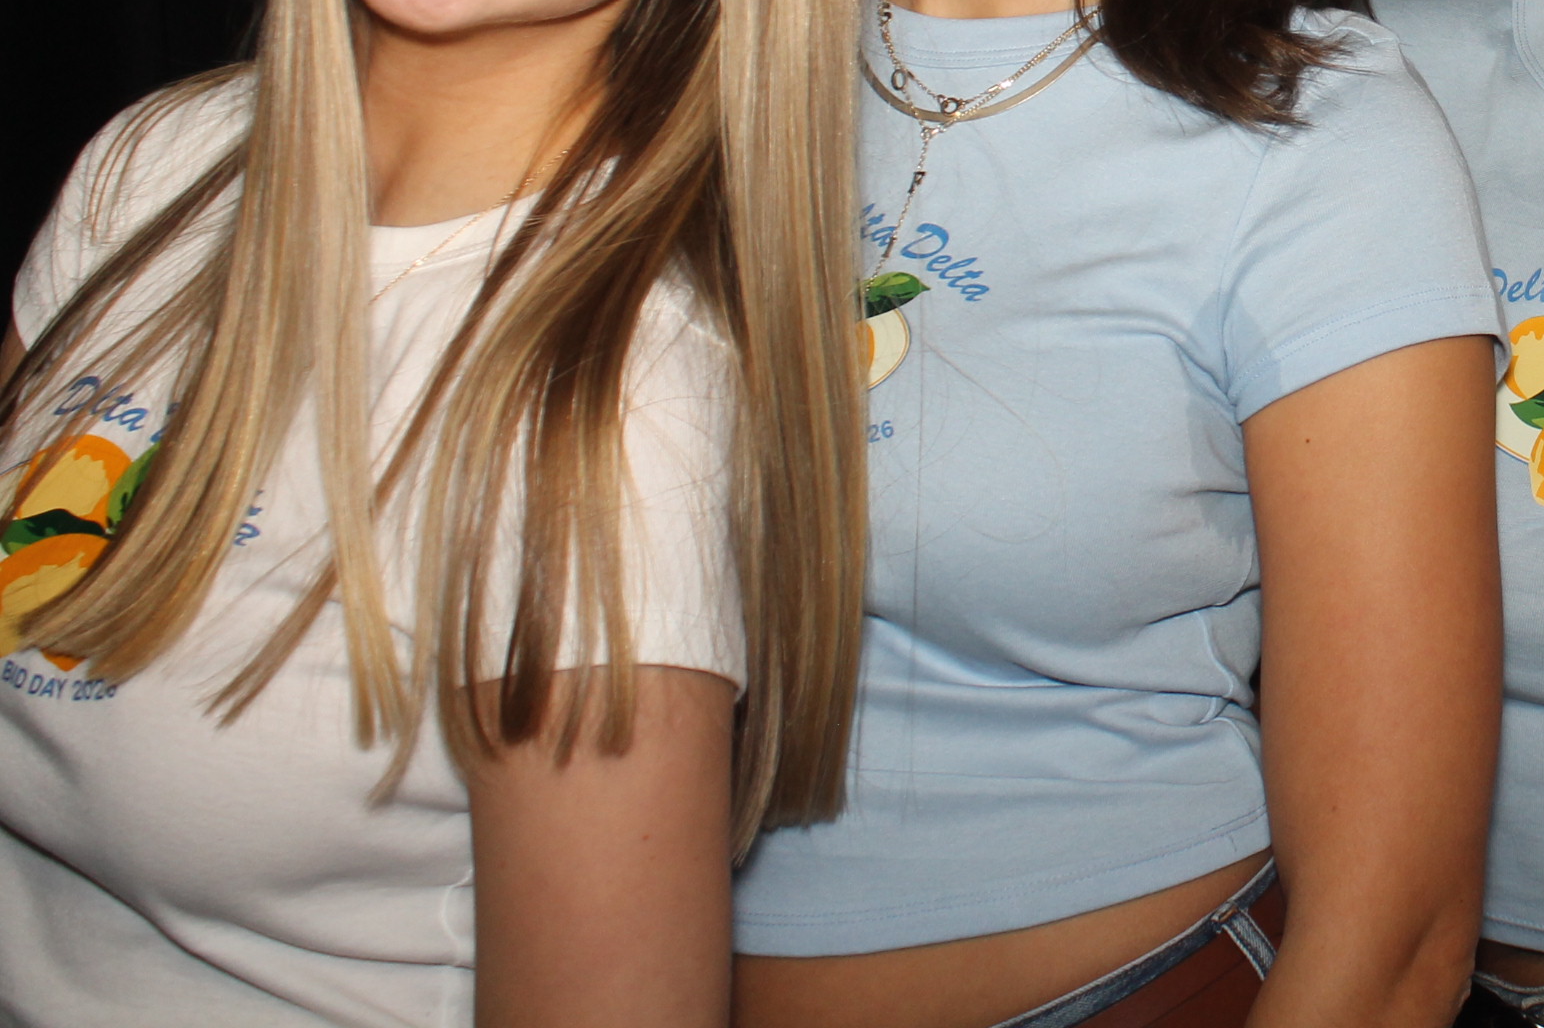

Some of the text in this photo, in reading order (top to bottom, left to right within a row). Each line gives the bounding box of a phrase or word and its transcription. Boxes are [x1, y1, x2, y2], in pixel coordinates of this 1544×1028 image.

[900, 222, 989, 301] Delta
[53, 376, 149, 432] Dlta
[866, 420, 894, 443] 26
[27, 674, 68, 699] DAY
